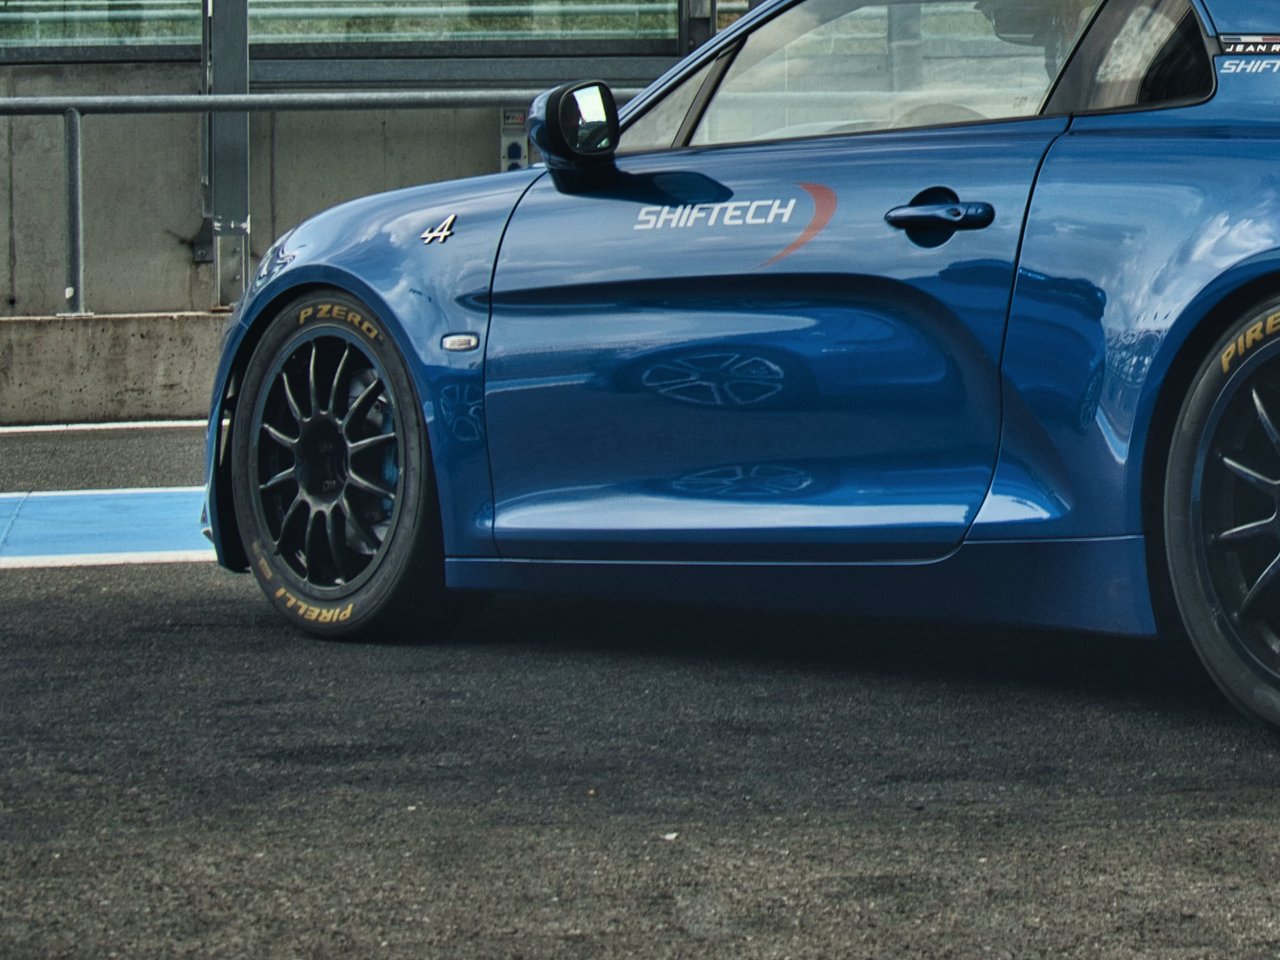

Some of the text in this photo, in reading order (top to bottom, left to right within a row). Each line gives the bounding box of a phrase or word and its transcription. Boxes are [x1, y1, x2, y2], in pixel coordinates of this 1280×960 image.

[1225, 43, 1267, 52] JEAN
[634, 197, 797, 231] SHIFTECH
[316, 303, 379, 340] ZERO
[275, 587, 354, 623] PIRELLI
